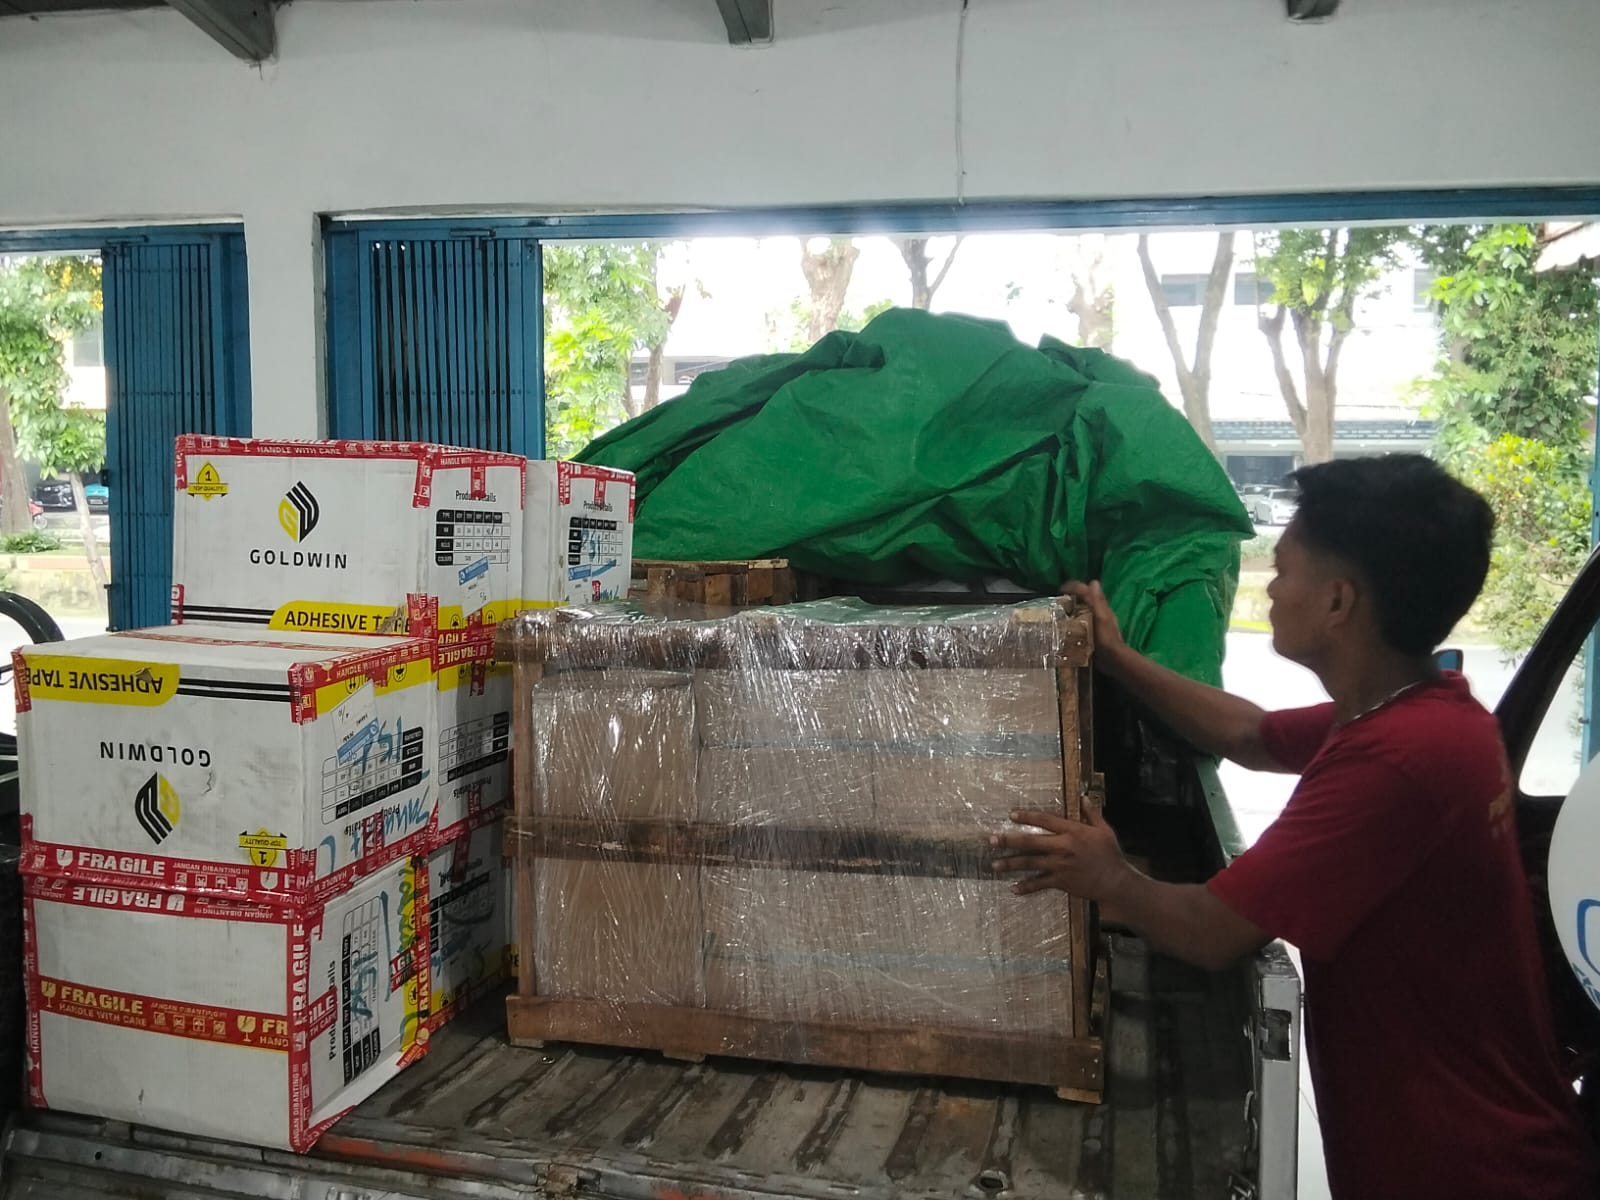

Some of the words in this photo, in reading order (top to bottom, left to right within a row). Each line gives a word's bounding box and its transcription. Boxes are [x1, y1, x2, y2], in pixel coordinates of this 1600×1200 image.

[256, 446, 291, 454] HANDLE
[294, 447, 317, 455] WITH
[319, 447, 341, 456] CARE
[205, 470, 212, 482] 1
[250, 549, 347, 569] GOLDWIN
[284, 610, 368, 630] ADHESIVE
[438, 632, 468, 644] AGILE
[336, 662, 362, 679] HANDLE
[69, 671, 163, 694] ADHESIVE
[100, 741, 211, 768] GOLDWIN
[244, 838, 269, 846] QUALITY
[78, 851, 165, 876] FRAGILE
[172, 862, 200, 871] JANGAN
[258, 851, 267, 864] 1
[72, 885, 161, 909] FRAGILE
[61, 985, 144, 1015] FRAGILE
[59, 1002, 94, 1018] HANDLE
[96, 1010, 120, 1022] WITH
[122, 1014, 147, 1027] CARE
